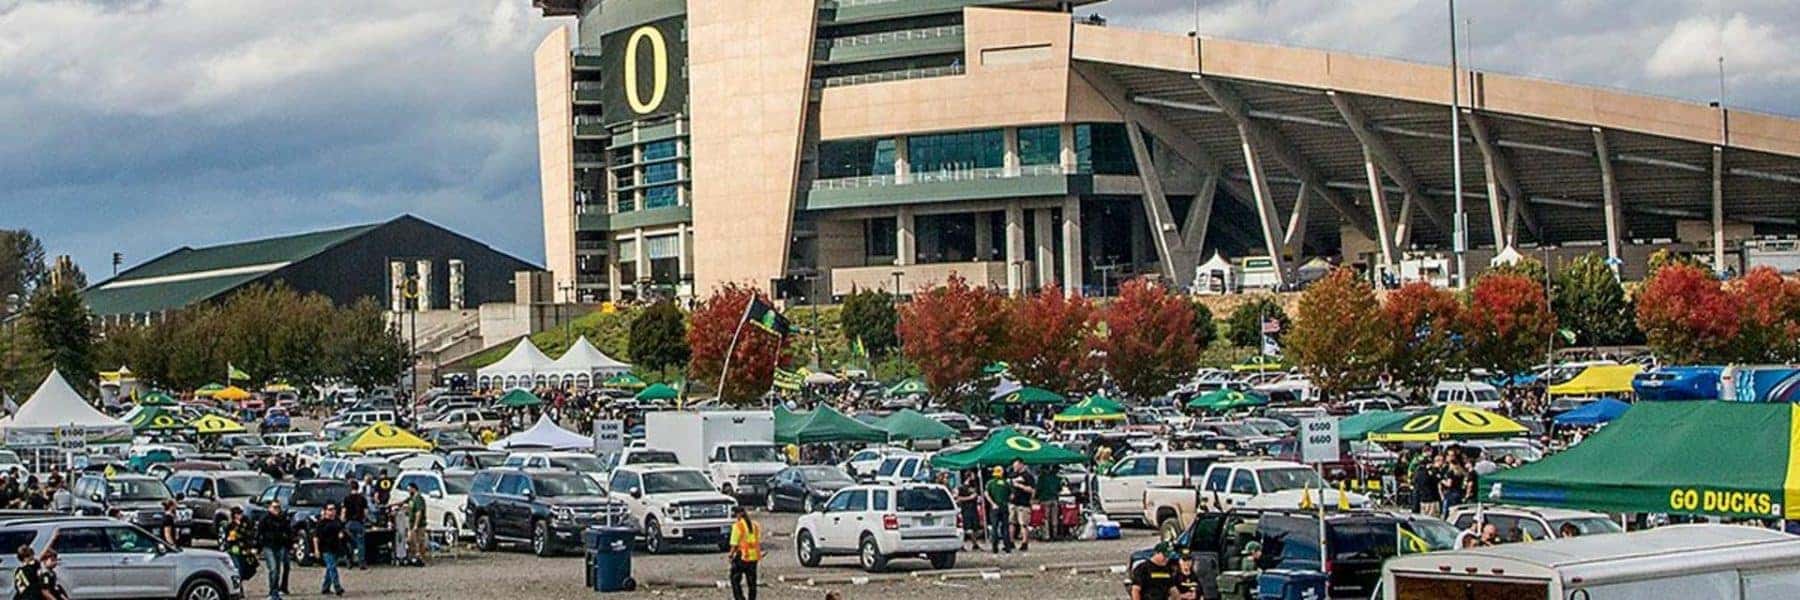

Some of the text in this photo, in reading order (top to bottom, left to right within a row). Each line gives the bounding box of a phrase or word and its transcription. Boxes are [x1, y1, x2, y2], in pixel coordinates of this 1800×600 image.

[1309, 422, 1331, 431] 6500
[1310, 434, 1332, 444] 6600
[1670, 488, 1771, 514] GO DUCKS
